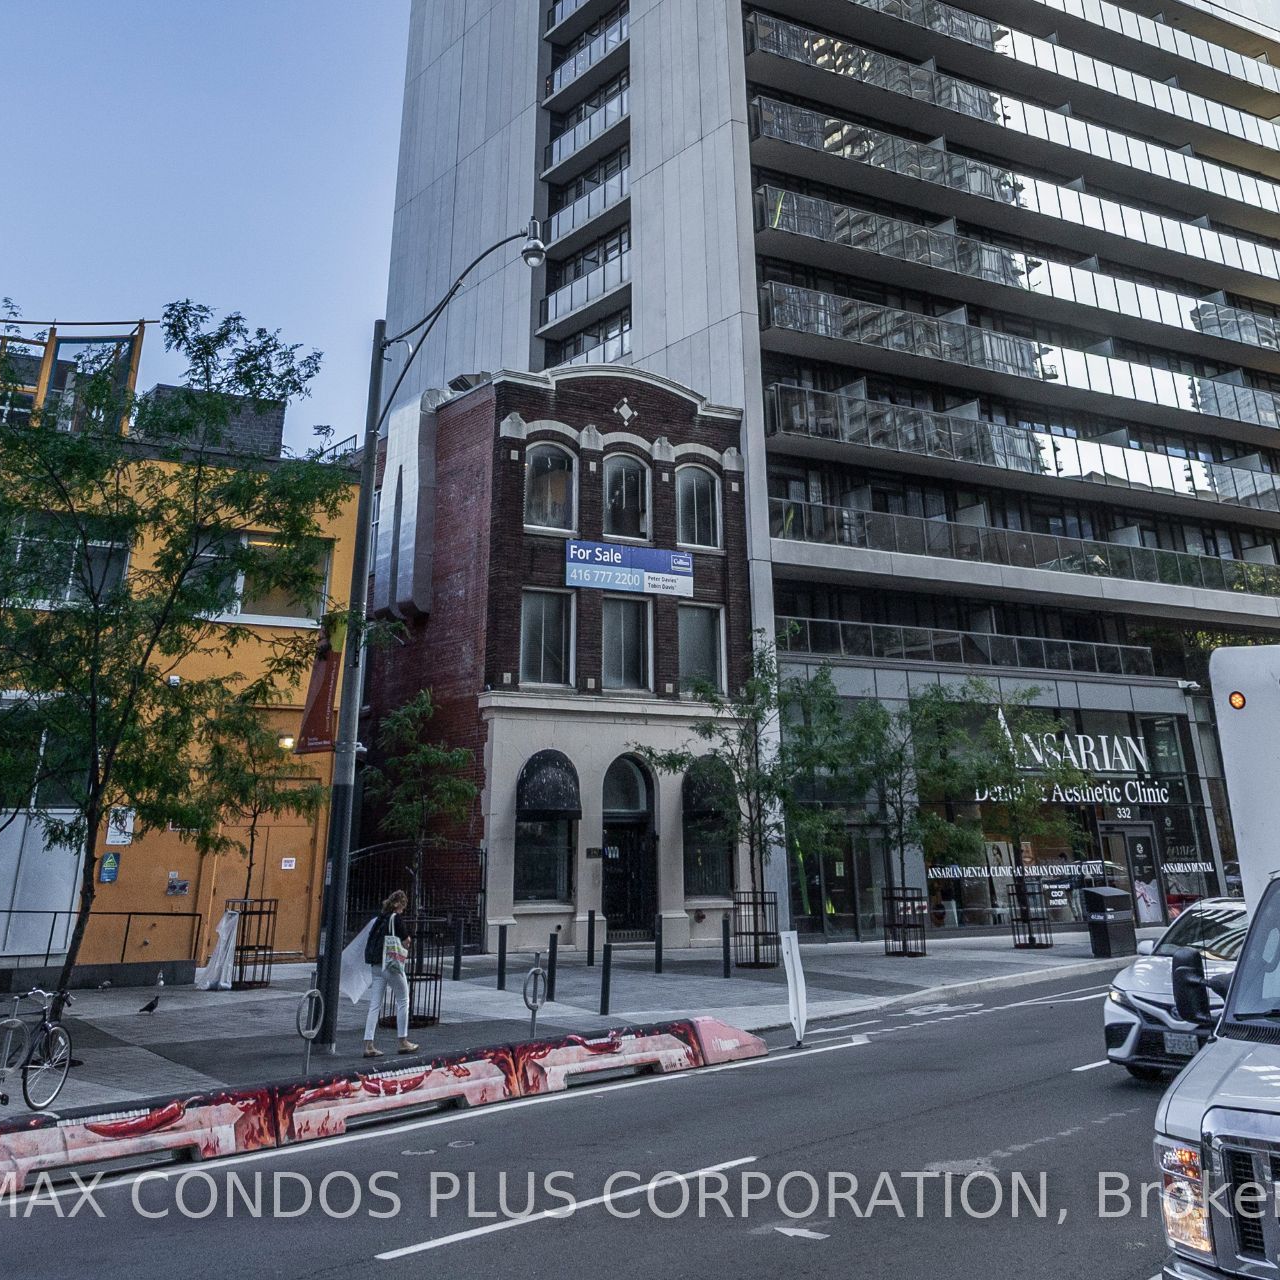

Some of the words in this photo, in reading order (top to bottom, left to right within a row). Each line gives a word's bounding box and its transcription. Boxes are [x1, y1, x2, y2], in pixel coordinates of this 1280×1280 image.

[570, 545, 592, 560] For
[594, 547, 622, 564] Sale
[570, 568, 591, 581] 416
[594, 570, 615, 584] 777
[615, 572, 640, 586] 2200
[1052, 780, 1122, 803] Aesthetic
[1124, 780, 1170, 804] Clinic
[1117, 807, 1131, 819] 332
[928, 867, 962, 879] ANSARIAN
[962, 866, 990, 878] DENTAL
[990, 865, 1013, 877] CLINIC
[1048, 864, 1081, 876] COSMETIC
[1081, 863, 1104, 875] CLINIC
